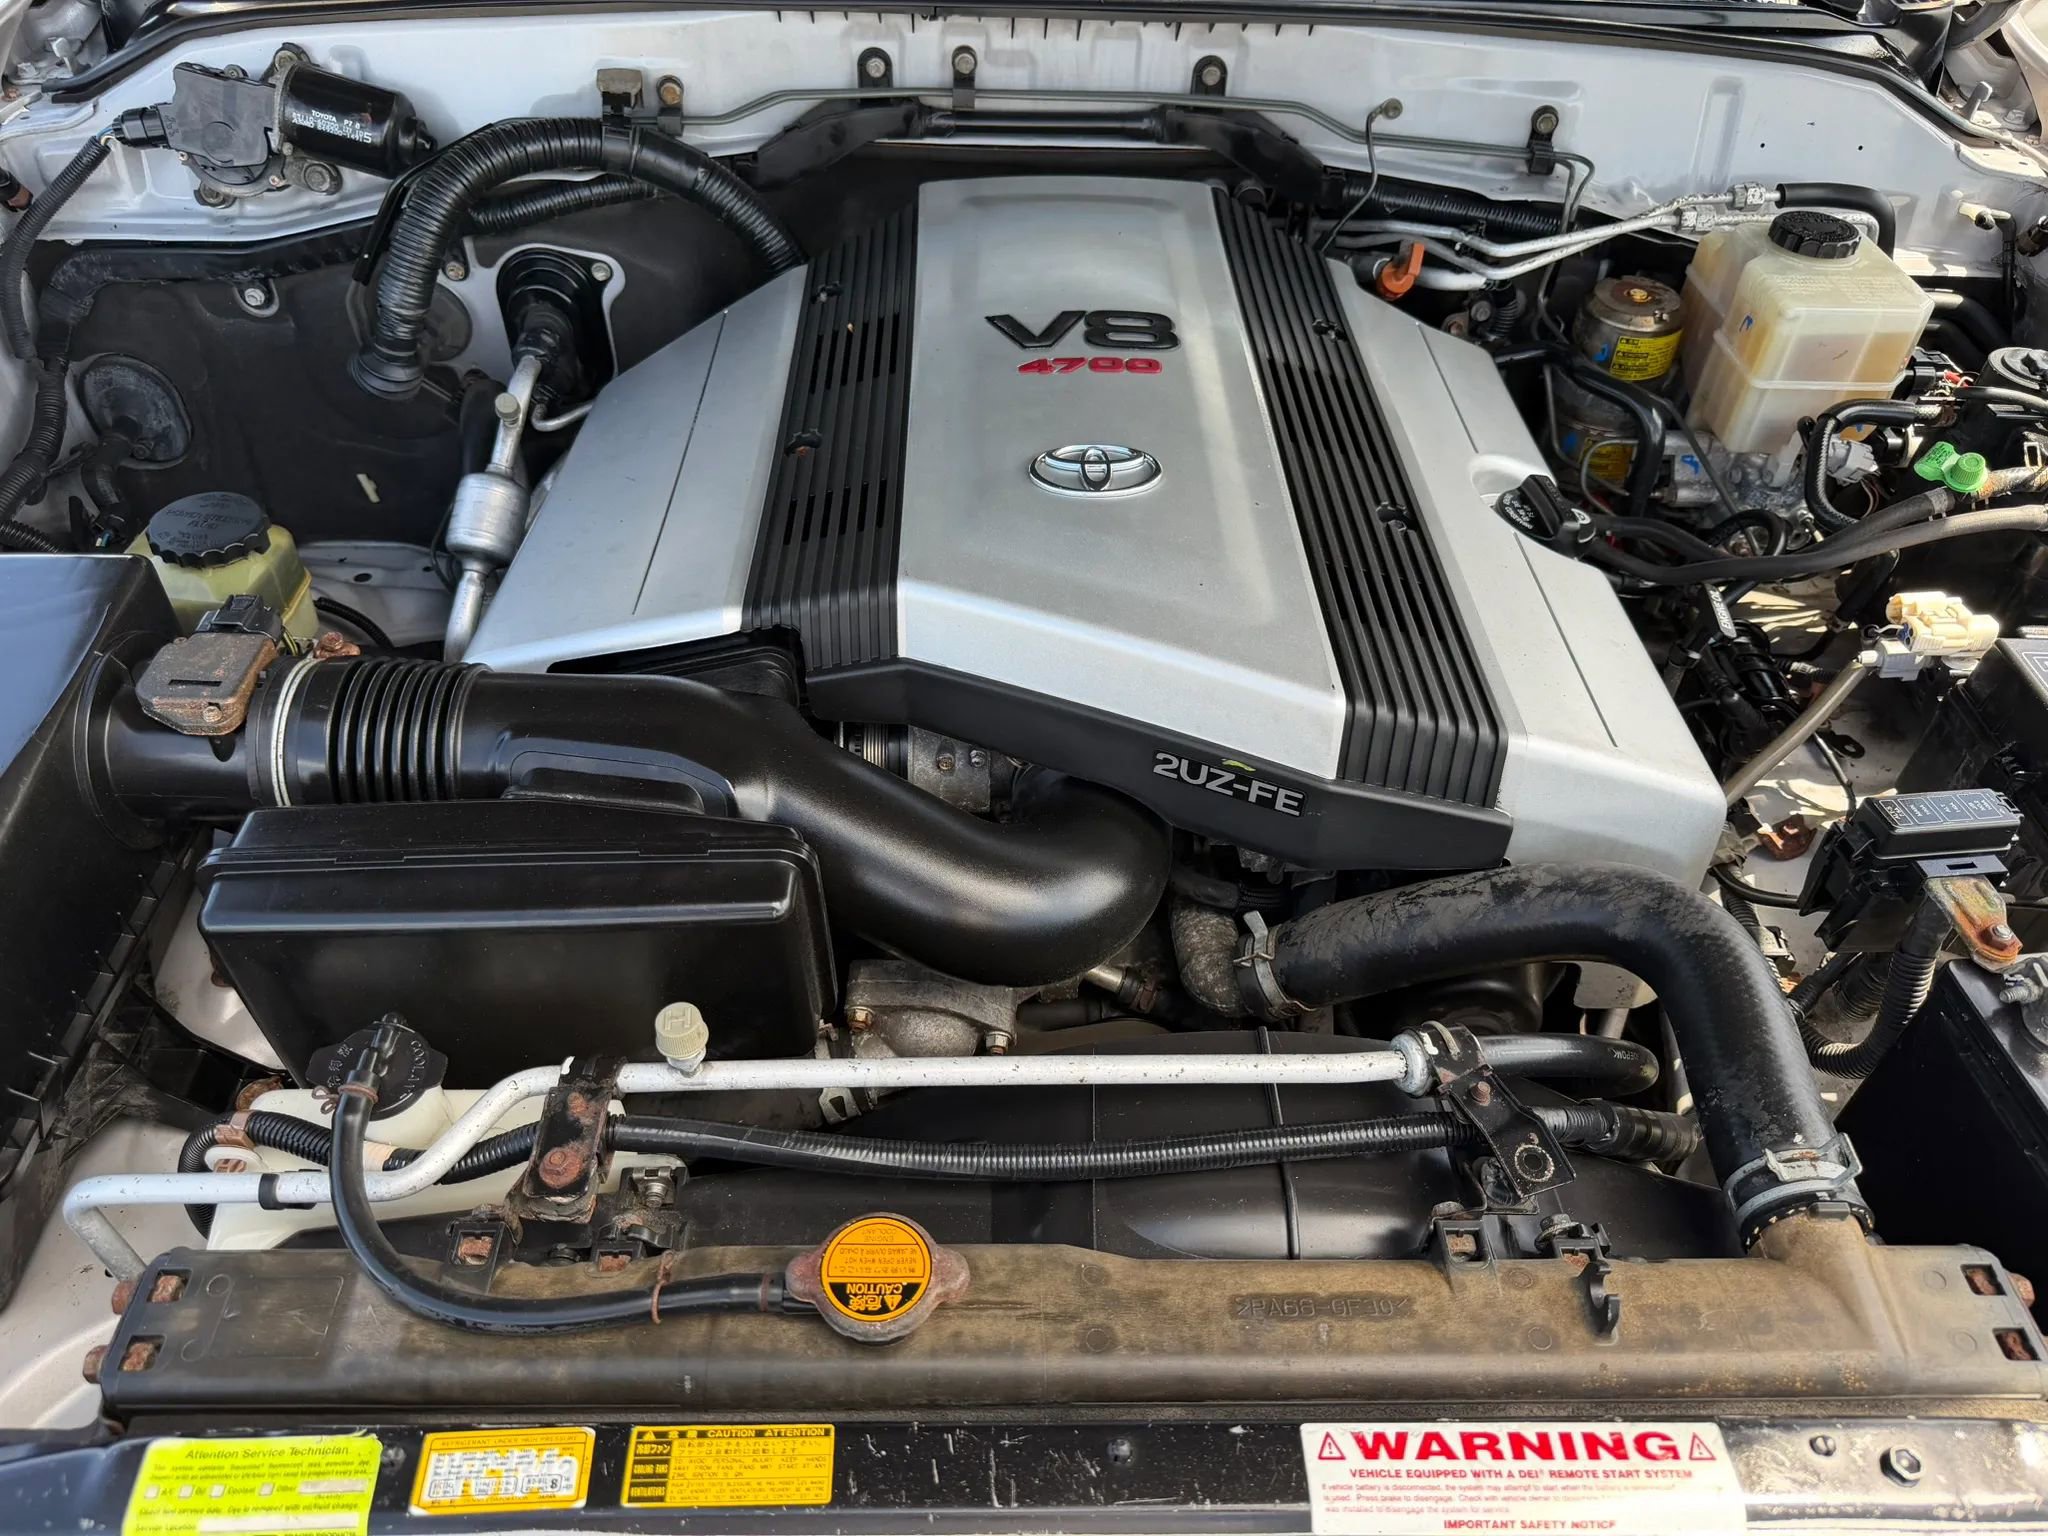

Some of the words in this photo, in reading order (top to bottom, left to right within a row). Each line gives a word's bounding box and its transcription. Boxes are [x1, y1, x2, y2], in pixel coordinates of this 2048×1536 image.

[311, 110, 337, 122] TOYOTA
[985, 309, 1181, 350] V8
[1018, 356, 1164, 375] 4700
[1153, 752, 1304, 817] 2UZ-FE
[664, 1007, 692, 1031] H
[897, 1257, 917, 1265] NEVER
[846, 1283, 903, 1295] CAUTION
[848, 1294, 882, 1311] 危険
[707, 1429, 756, 1438] CAUTION
[764, 1428, 825, 1437] ATTENTION
[441, 1438, 490, 1447] REFRIGERANT
[494, 1437, 518, 1445] UNDER
[541, 1434, 578, 1442] PRESSURE
[1350, 1431, 1681, 1461] WARNING
[186, 1449, 239, 1459] Attention
[242, 1448, 286, 1458] Service
[290, 1446, 349, 1457] Technician
[1350, 1468, 1401, 1478] VEHICLE
[1406, 1468, 1467, 1479] EQUIPPED
[1470, 1469, 1503, 1478] WITH
[1507, 1469, 1515, 1478] A
[1550, 1469, 1599, 1479] REMOTE
[1602, 1469, 1642, 1479] START
[1645, 1469, 1693, 1479] SYSTEM
[550, 1478, 558, 1490] 8
[1328, 1483, 1353, 1491] vehicle
[1356, 1483, 1381, 1492] battery
[1445, 1483, 1457, 1491] the
[1458, 1484, 1483, 1492] system
[1504, 1484, 1532, 1493] attempt
[1356, 1493, 1379, 1501] Press
[1458, 1493, 1482, 1501] Check
[1444, 1520, 1516, 1529] IMPORTANT
[1520, 1520, 1566, 1529] SAFETY
